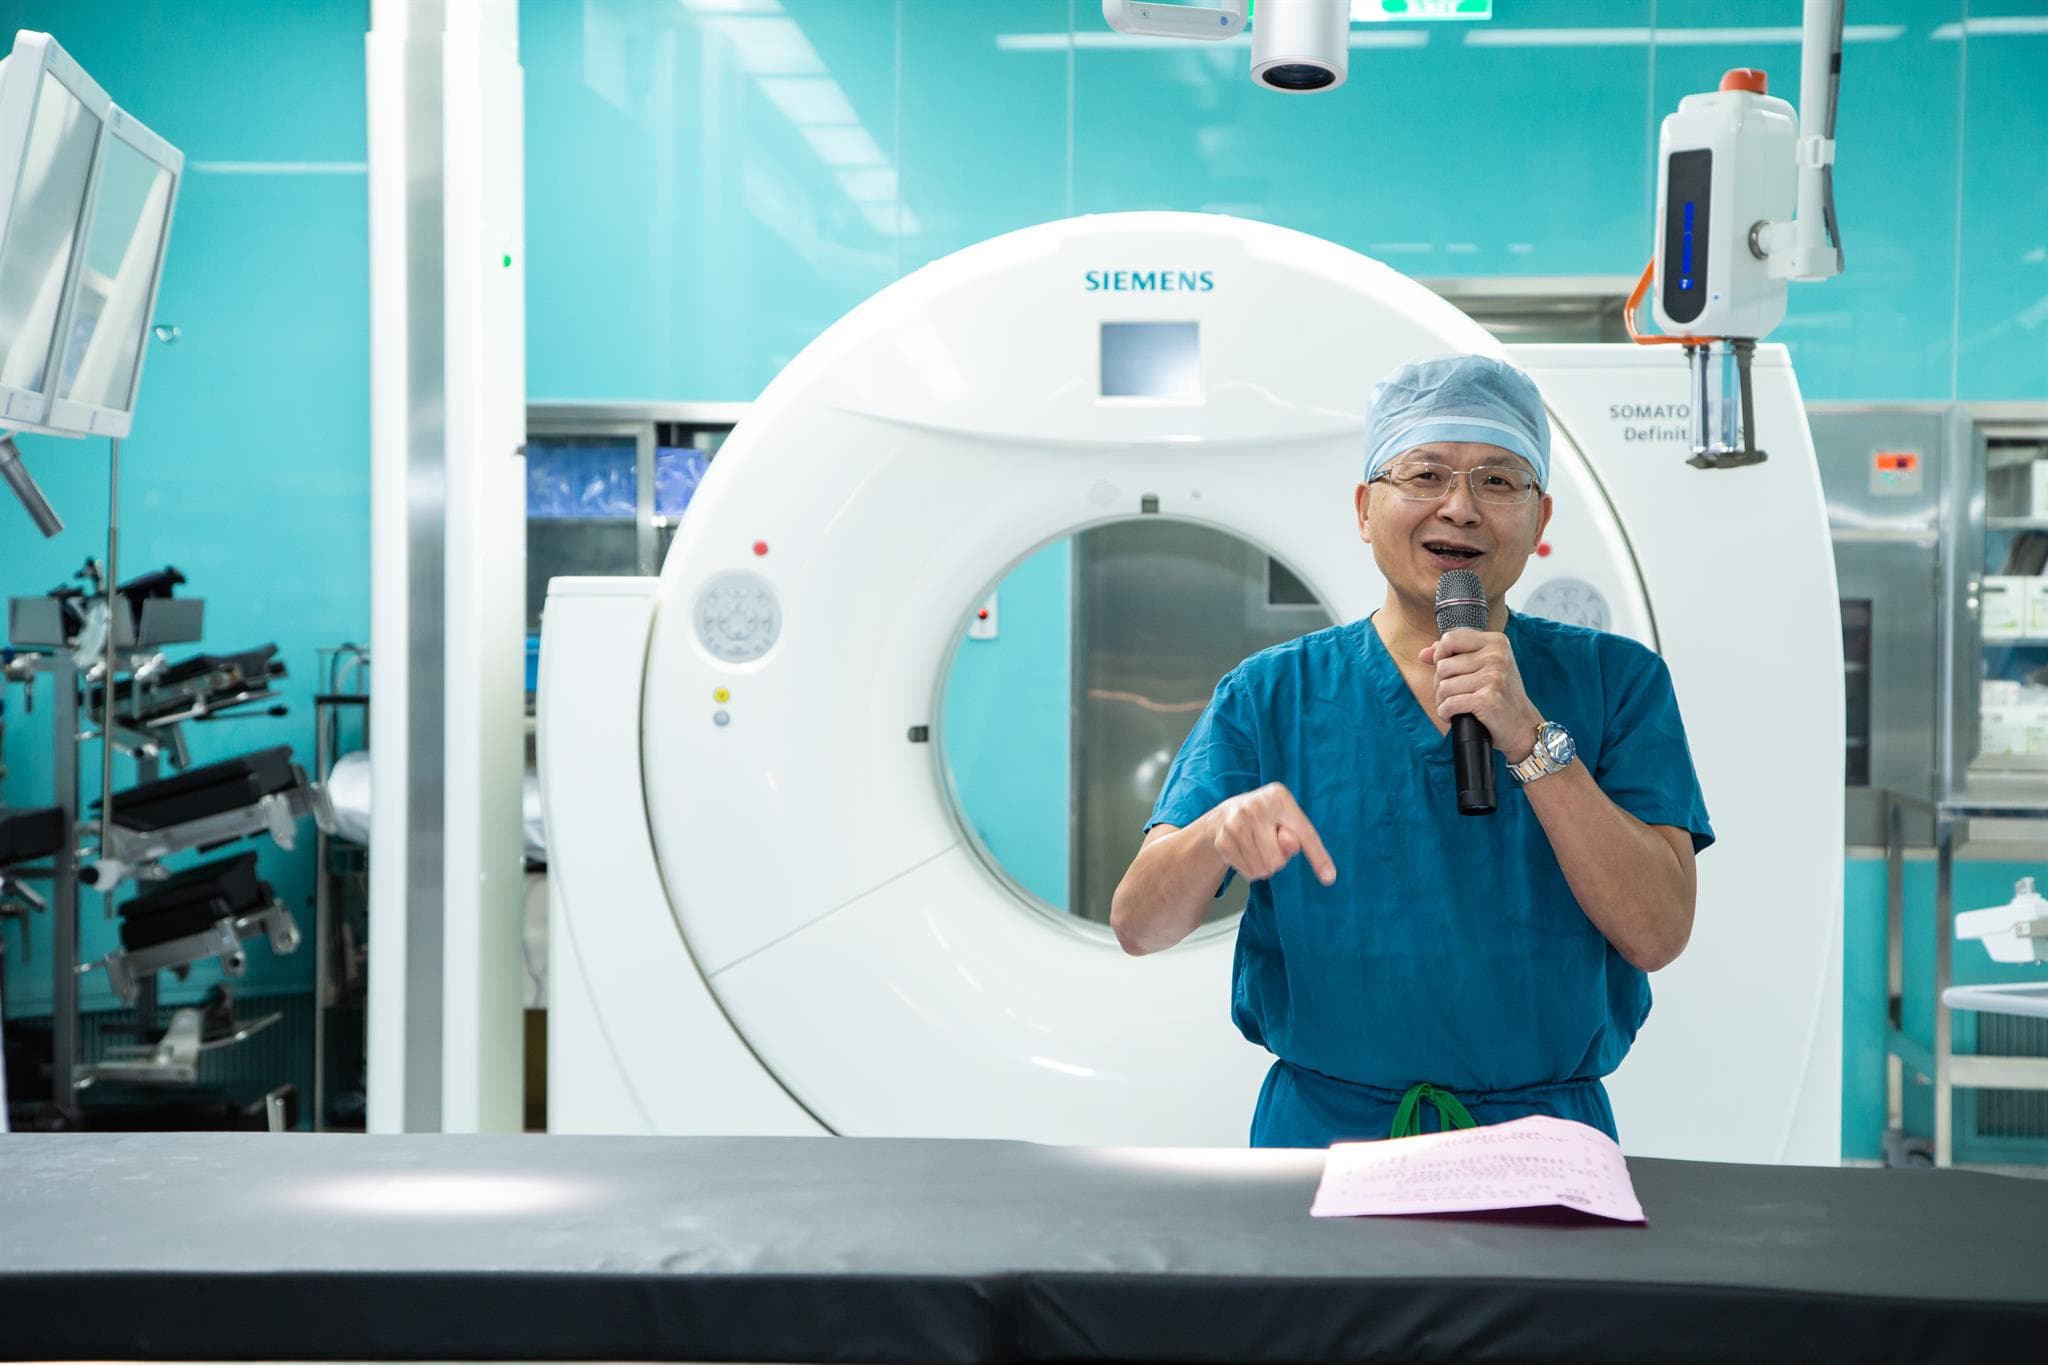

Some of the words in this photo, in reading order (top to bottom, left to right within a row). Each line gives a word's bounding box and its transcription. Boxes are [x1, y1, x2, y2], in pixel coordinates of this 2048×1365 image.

[1085, 270, 1215, 292] SIEMENS
[1609, 404, 1690, 419] SOMATO
[1624, 426, 1689, 442] Definit
